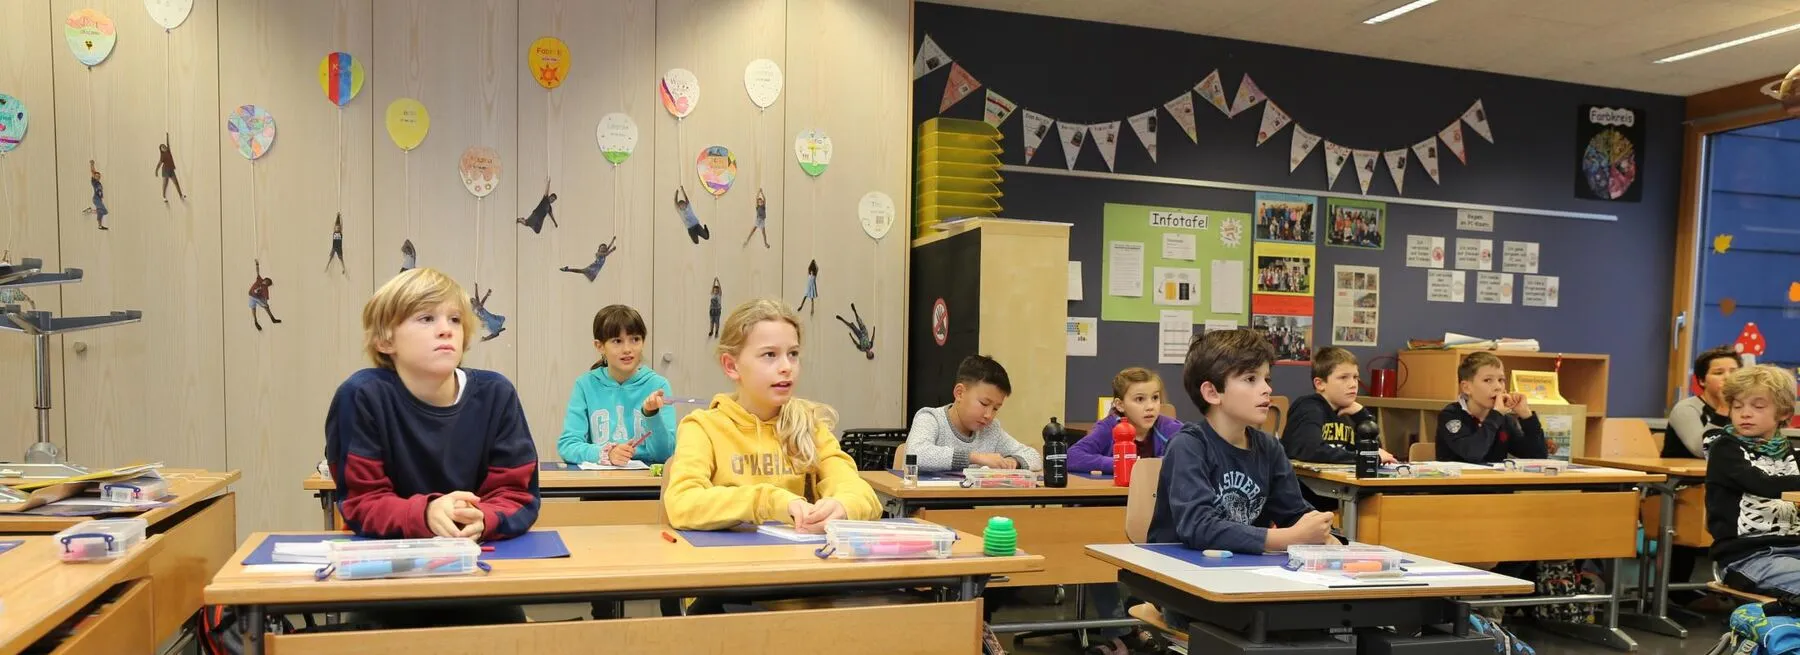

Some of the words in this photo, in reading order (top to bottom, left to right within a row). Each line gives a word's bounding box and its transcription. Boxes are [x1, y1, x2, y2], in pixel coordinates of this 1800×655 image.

[1591, 110, 1632, 123] Farbkreis
[1152, 213, 1208, 228] Infotafel
[731, 453, 792, 475] O'NEIL
